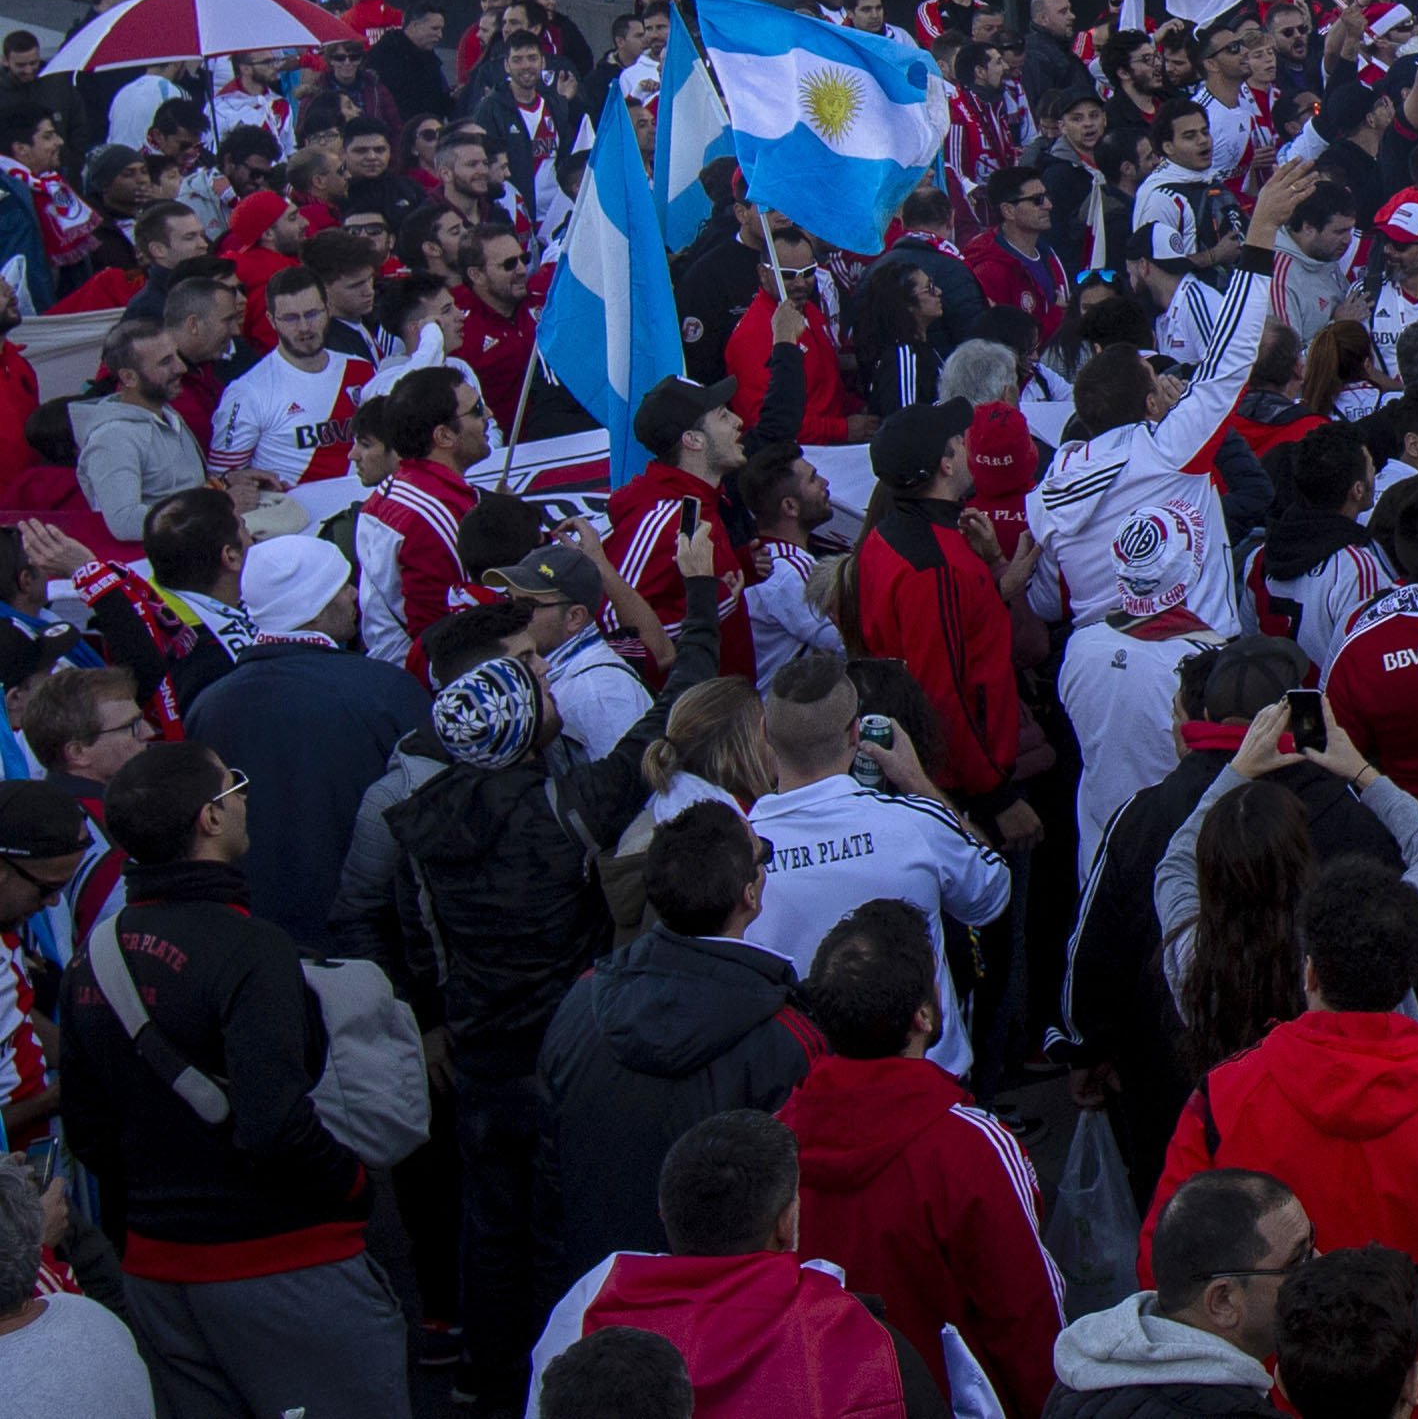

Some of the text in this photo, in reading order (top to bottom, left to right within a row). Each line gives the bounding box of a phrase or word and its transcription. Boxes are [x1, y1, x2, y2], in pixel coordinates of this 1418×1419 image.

[1371, 331, 1399, 345] BBV
[296, 419, 353, 448] BBV
[818, 832, 874, 865] PLATE
[140, 937, 189, 974] PLATE
